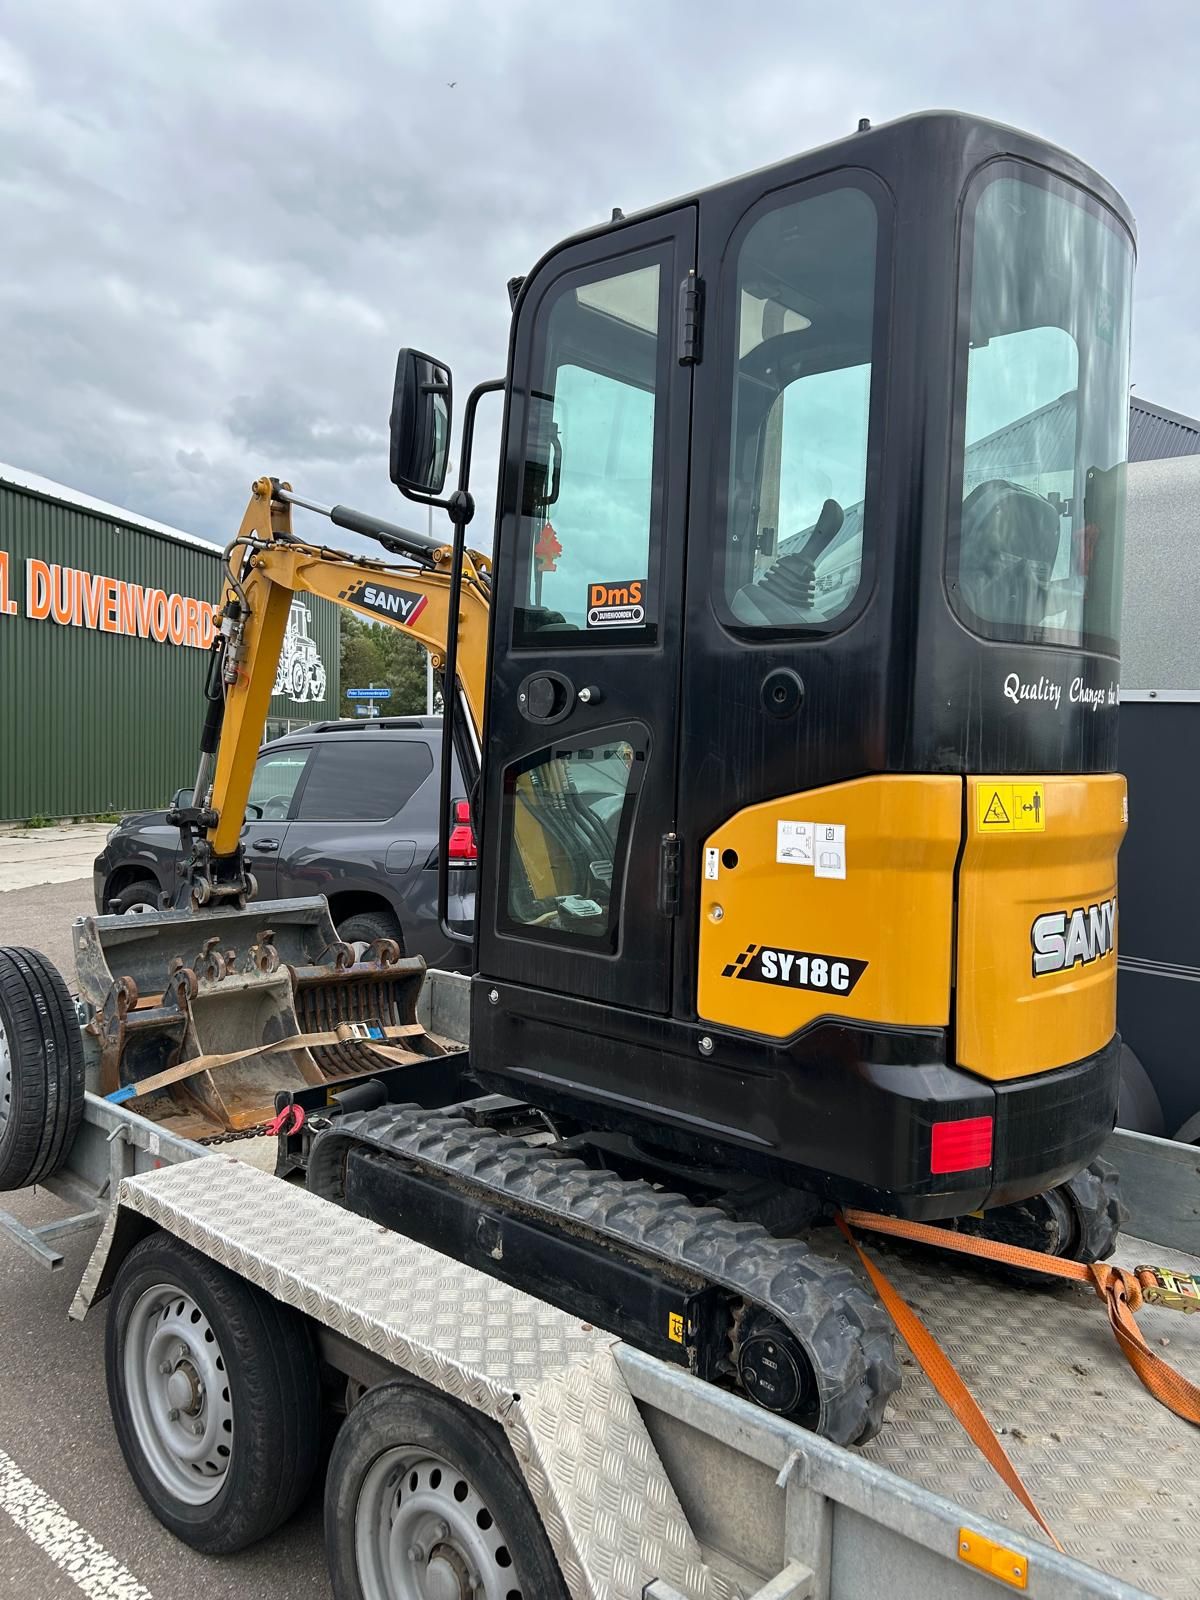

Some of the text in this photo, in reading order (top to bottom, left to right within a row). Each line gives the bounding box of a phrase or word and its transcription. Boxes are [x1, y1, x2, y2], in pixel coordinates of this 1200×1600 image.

[26, 558, 220, 651] DUIVENVOORD
[363, 586, 413, 616] SANY
[591, 582, 642, 607] DmS
[1003, 672, 1062, 711] Quality
[1068, 676, 1105, 712] Changes
[1031, 896, 1117, 977] SANY
[761, 950, 850, 991] SY18C
